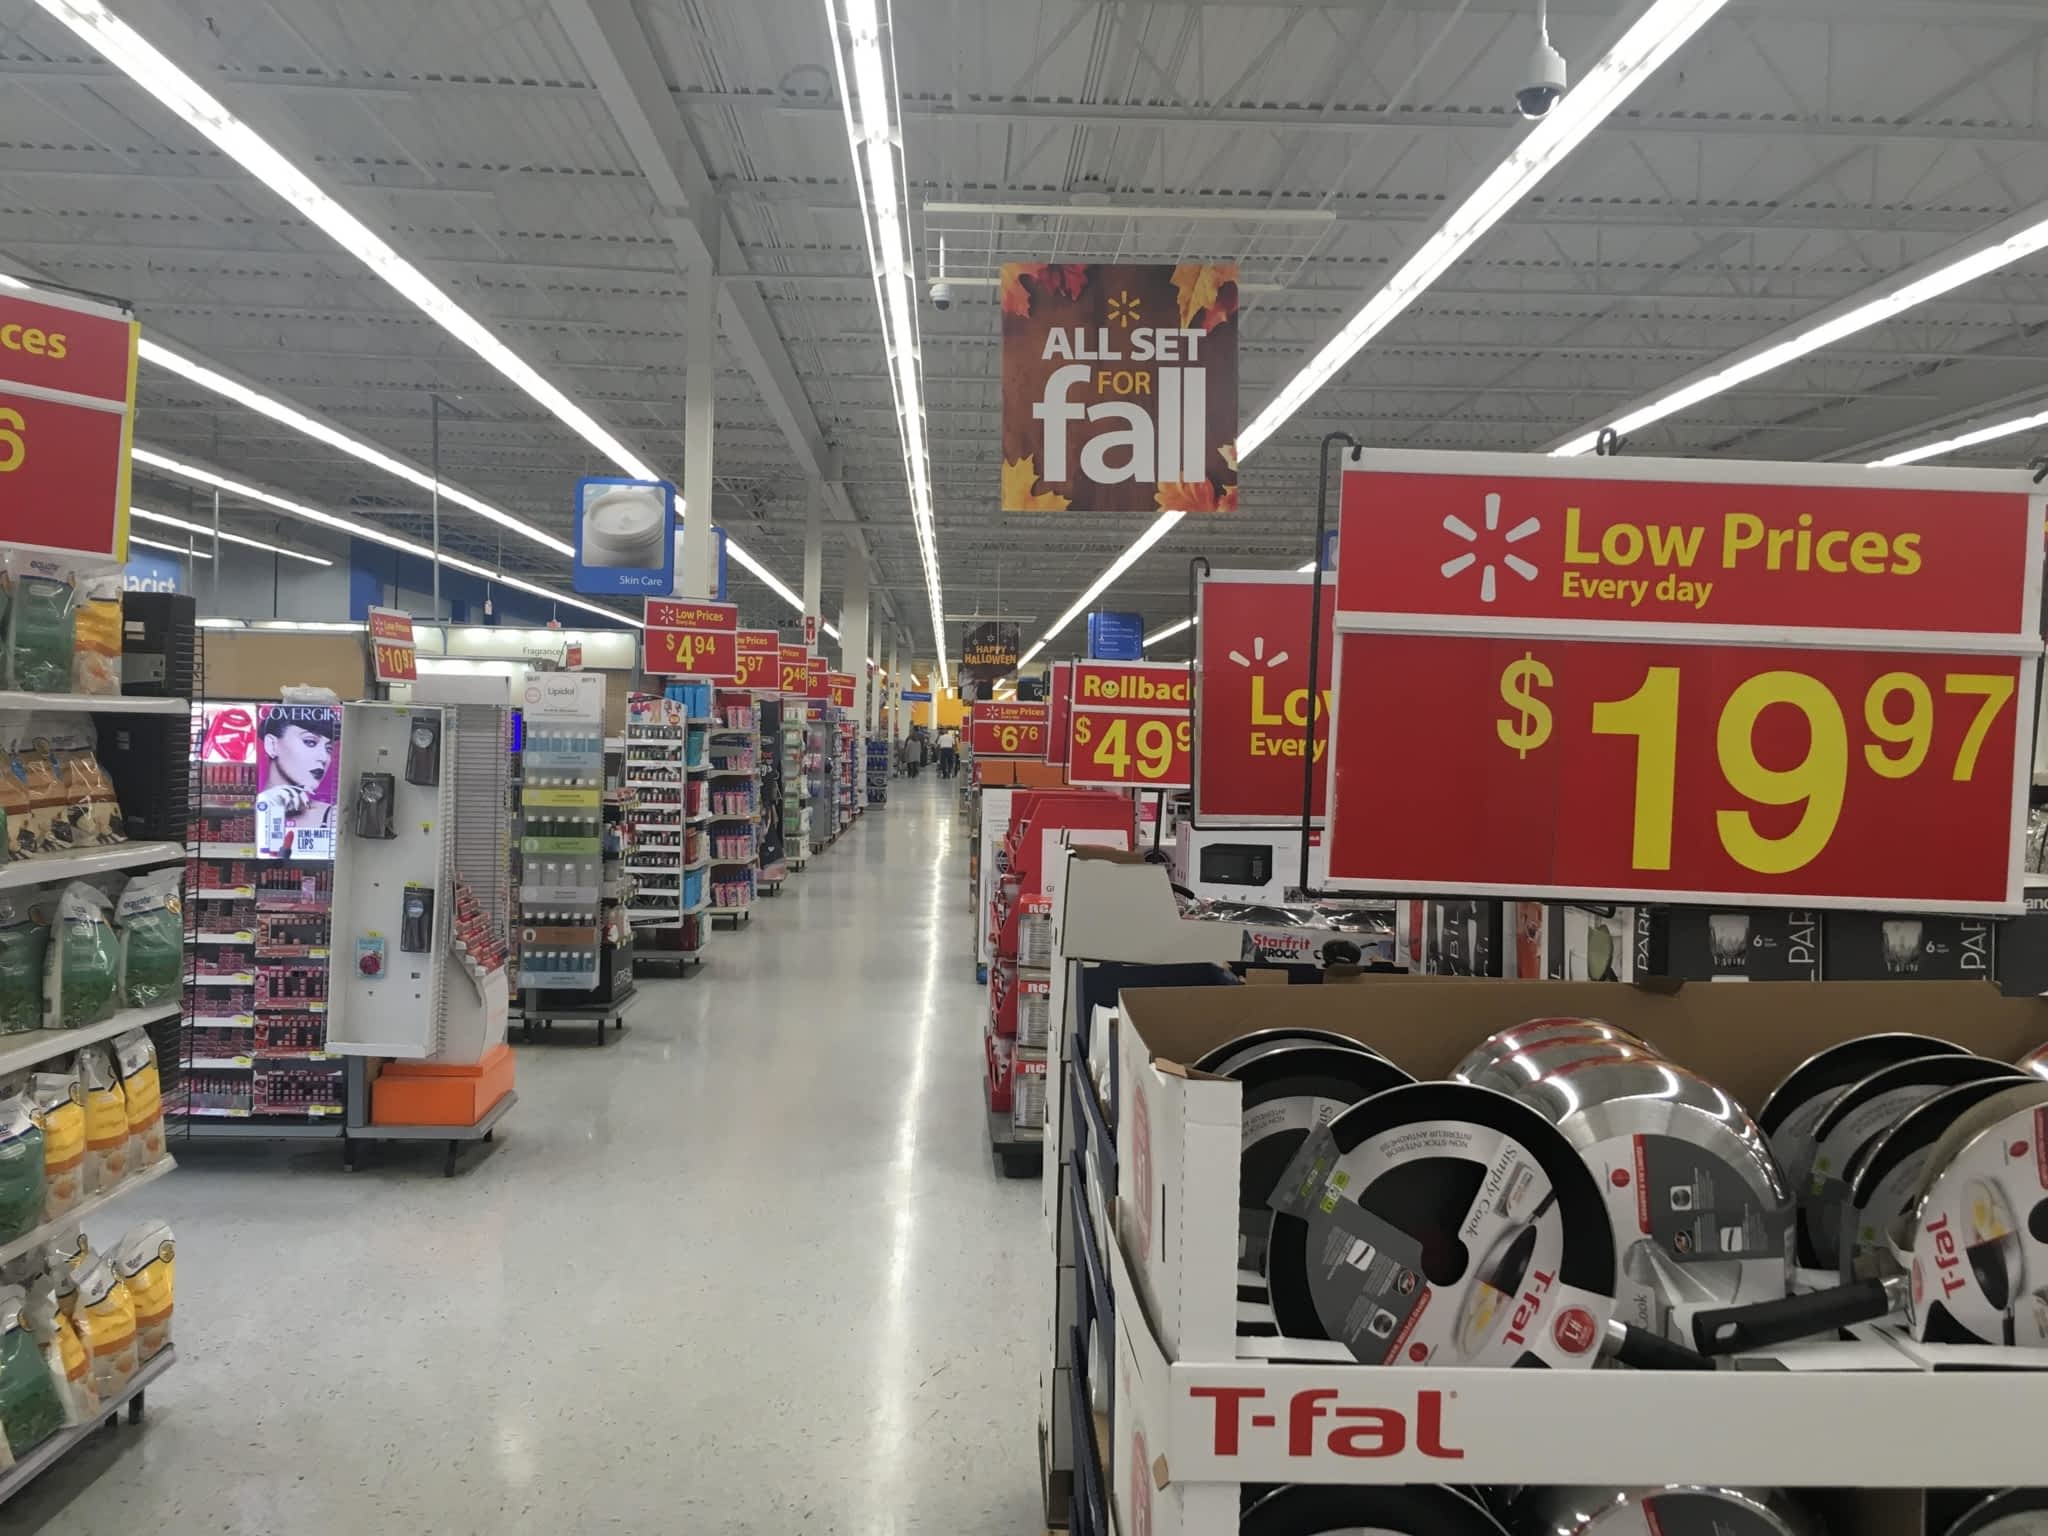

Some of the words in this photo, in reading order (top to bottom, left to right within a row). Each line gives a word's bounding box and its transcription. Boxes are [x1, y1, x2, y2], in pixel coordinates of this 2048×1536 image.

[1041, 327, 1122, 361] ALL
[1130, 327, 1207, 361] SET
[1097, 371, 1151, 395] FOR
[1032, 363, 1207, 485] fall
[1562, 506, 1704, 567] Low
[1722, 512, 1923, 577] Prices
[124, 570, 176, 593] acist
[619, 575, 640, 586] Skin
[641, 576, 663, 587] Care
[1562, 570, 1649, 609] Every
[1656, 573, 1713, 610] day
[676, 608, 695, 620] Low
[696, 610, 724, 622] Prices
[964, 653, 1017, 665] HALLOWEEN
[975, 645, 1007, 655] HAPPY
[1083, 674, 1190, 701] Rollbac
[1251, 675, 1334, 727] Lo
[1250, 732, 1328, 764] Every
[297, 838, 314, 850] LIPS
[1253, 933, 1312, 951] Starfrit
[1753, 935, 1763, 947] 6
[1926, 941, 1936, 954] 6
[1486, 1144, 1519, 1197] Simply
[1463, 1197, 1491, 1238] Cook
[1926, 1212, 1966, 1299] T-fal
[1502, 1269, 1556, 1346] T-fal
[1188, 1386, 1465, 1460] T-fal
